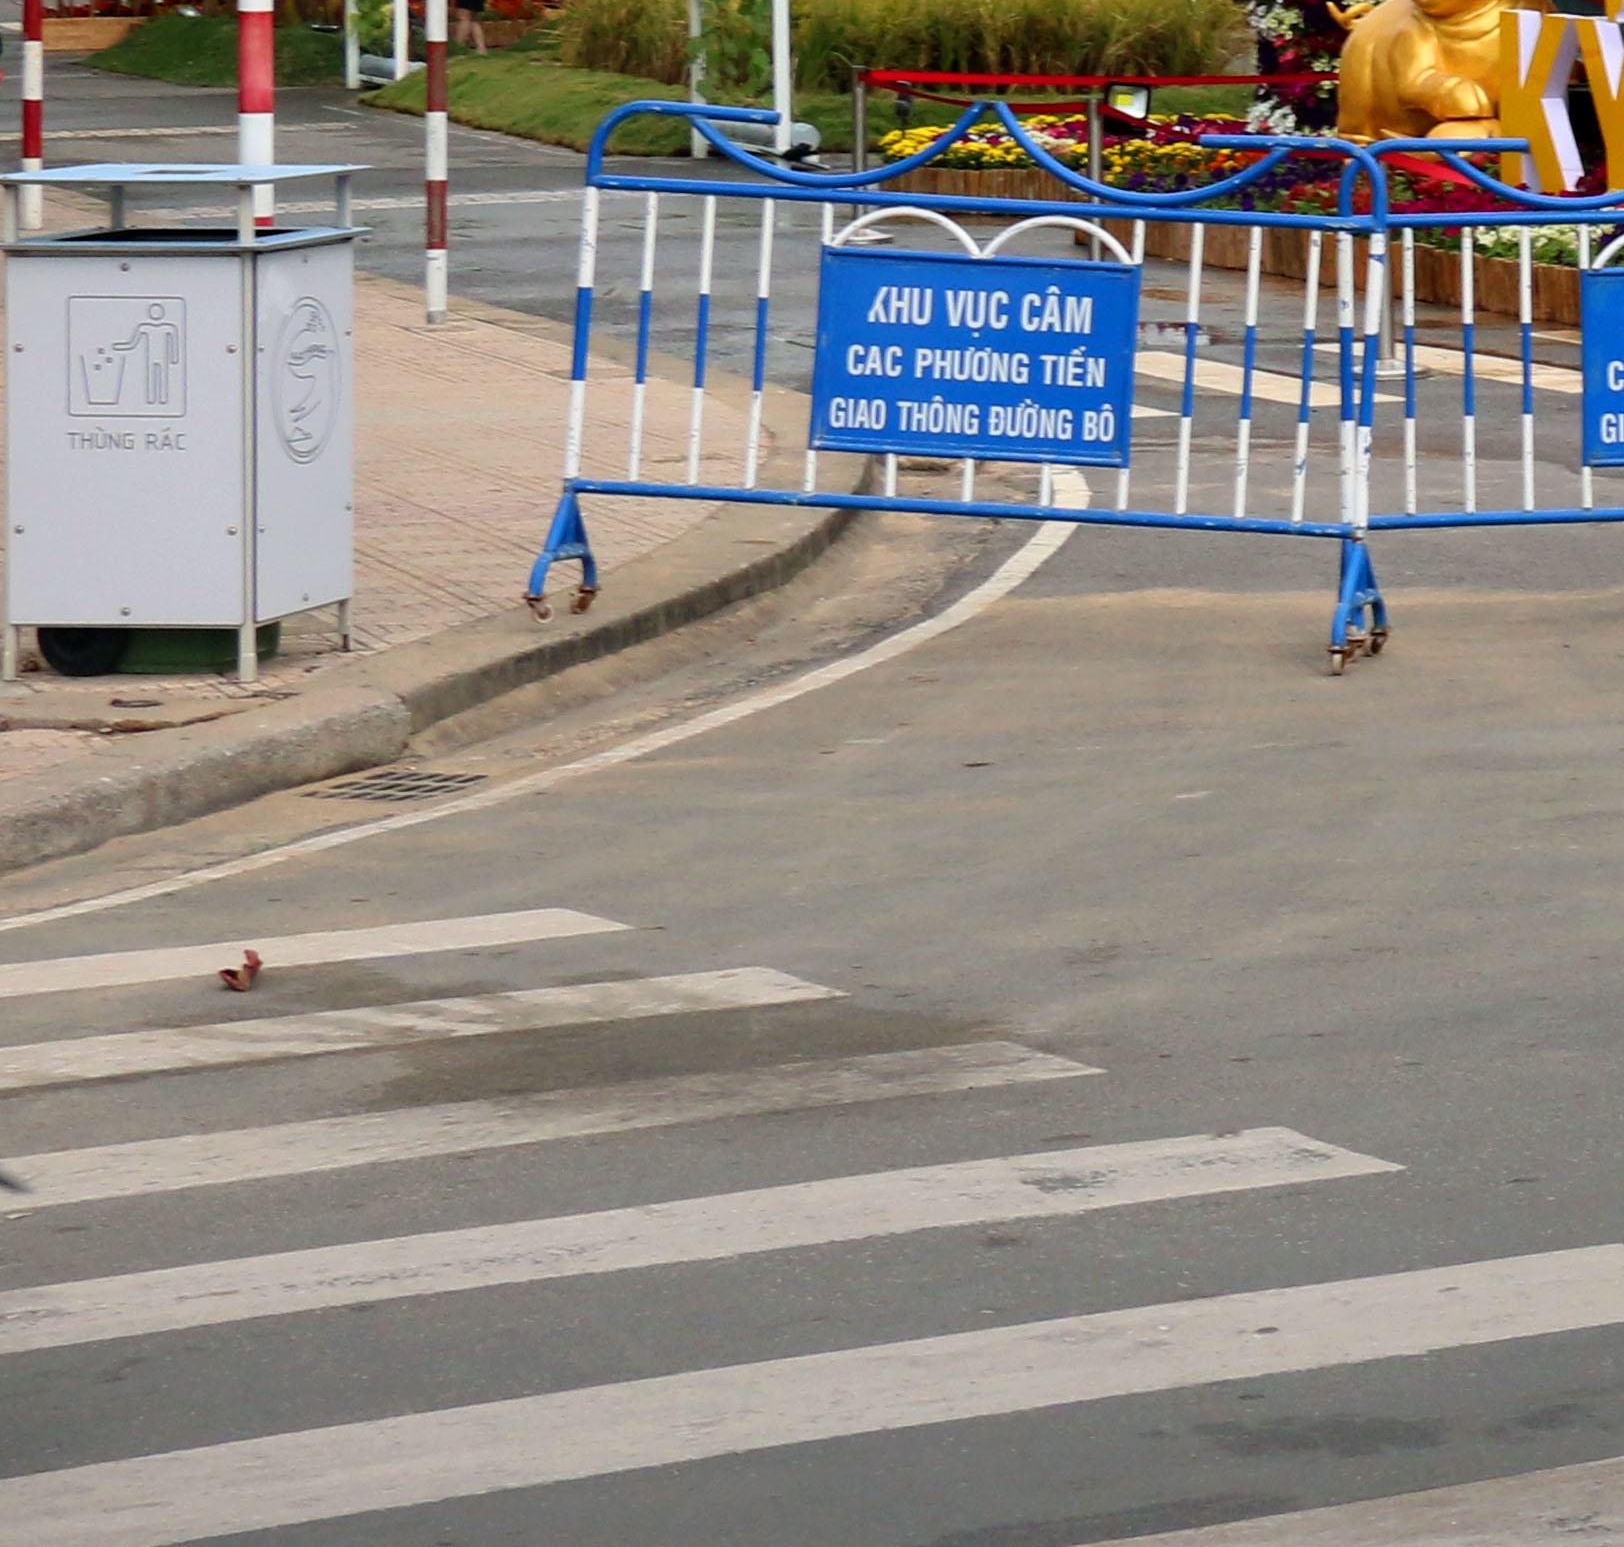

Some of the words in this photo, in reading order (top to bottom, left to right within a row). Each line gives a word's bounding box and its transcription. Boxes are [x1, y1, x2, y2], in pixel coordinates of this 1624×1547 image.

[914, 346, 1031, 385] PHƯƠNG
[829, 396, 887, 430] GIAO
[896, 395, 981, 436] THÔNG
[988, 398, 1074, 441] ĐƯỜNG
[66, 426, 136, 451] THÙNG
[146, 427, 188, 451] RÁC
